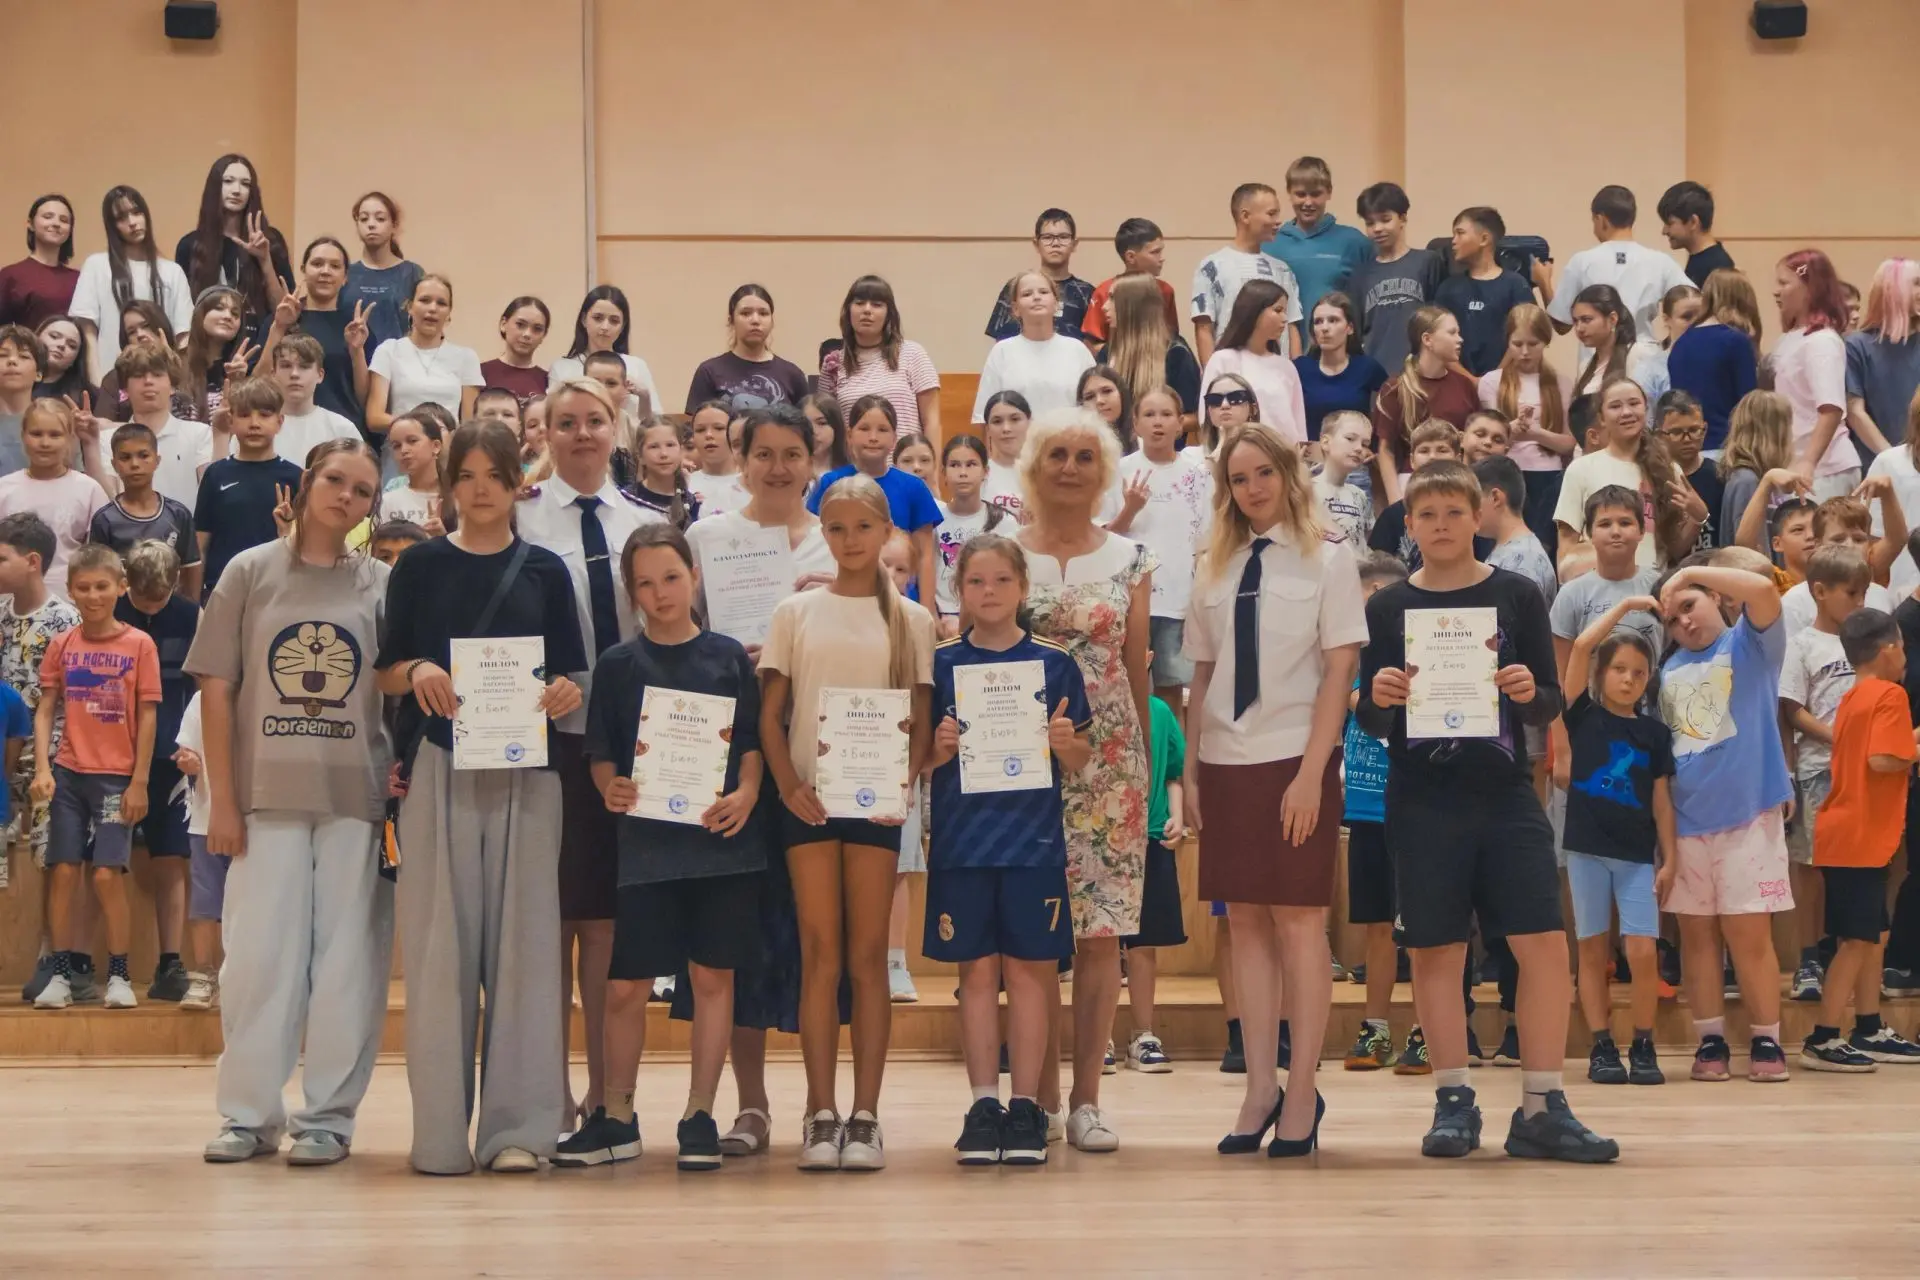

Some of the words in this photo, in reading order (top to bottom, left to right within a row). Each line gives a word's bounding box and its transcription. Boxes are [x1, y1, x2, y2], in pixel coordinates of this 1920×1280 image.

[1431, 631, 1473, 639] ДИПЛОМ
[478, 660, 520, 669] ДИПЛОМ
[981, 685, 1021, 694] ДИПЛОМ
[667, 712, 708, 724] ДИПЛОМ
[843, 711, 886, 719] ДИПЛОМ
[1044, 897, 1062, 931] 7
